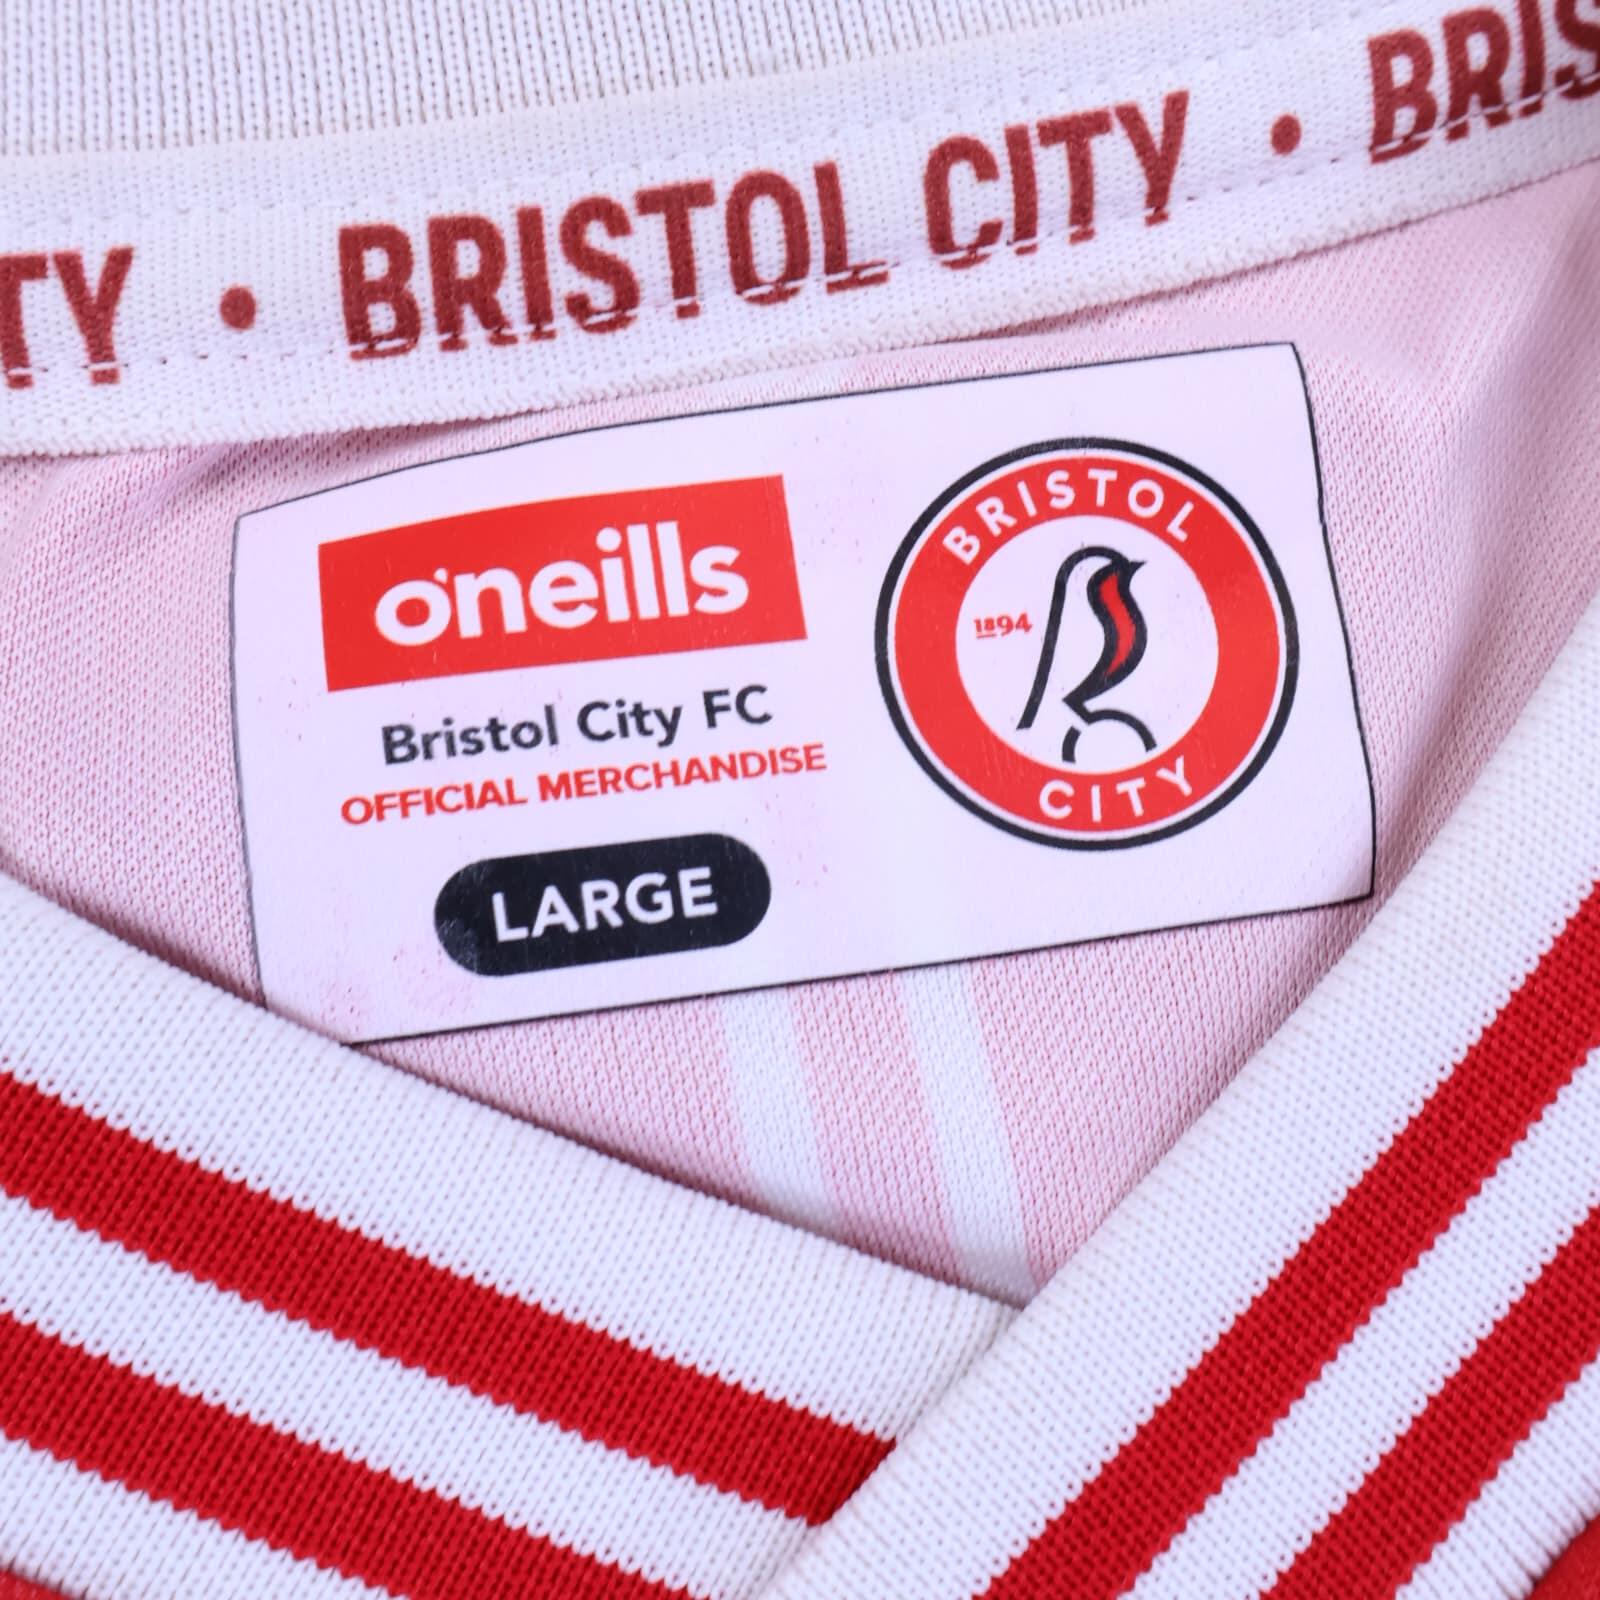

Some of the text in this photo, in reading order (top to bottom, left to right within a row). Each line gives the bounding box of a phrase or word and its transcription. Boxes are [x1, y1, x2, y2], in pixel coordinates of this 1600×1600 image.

[338, 161, 889, 361] BRISTOL
[923, 90, 1190, 270] CITY
[942, 468, 1195, 566] BRISTOL
[374, 520, 749, 647] o'neills
[973, 611, 1033, 640] 1894
[381, 684, 774, 765] Bristol City FC
[340, 743, 827, 825] OFFICIAL MERCHANDISE
[1038, 756, 1193, 823] CITY
[491, 866, 719, 943] LARGE
